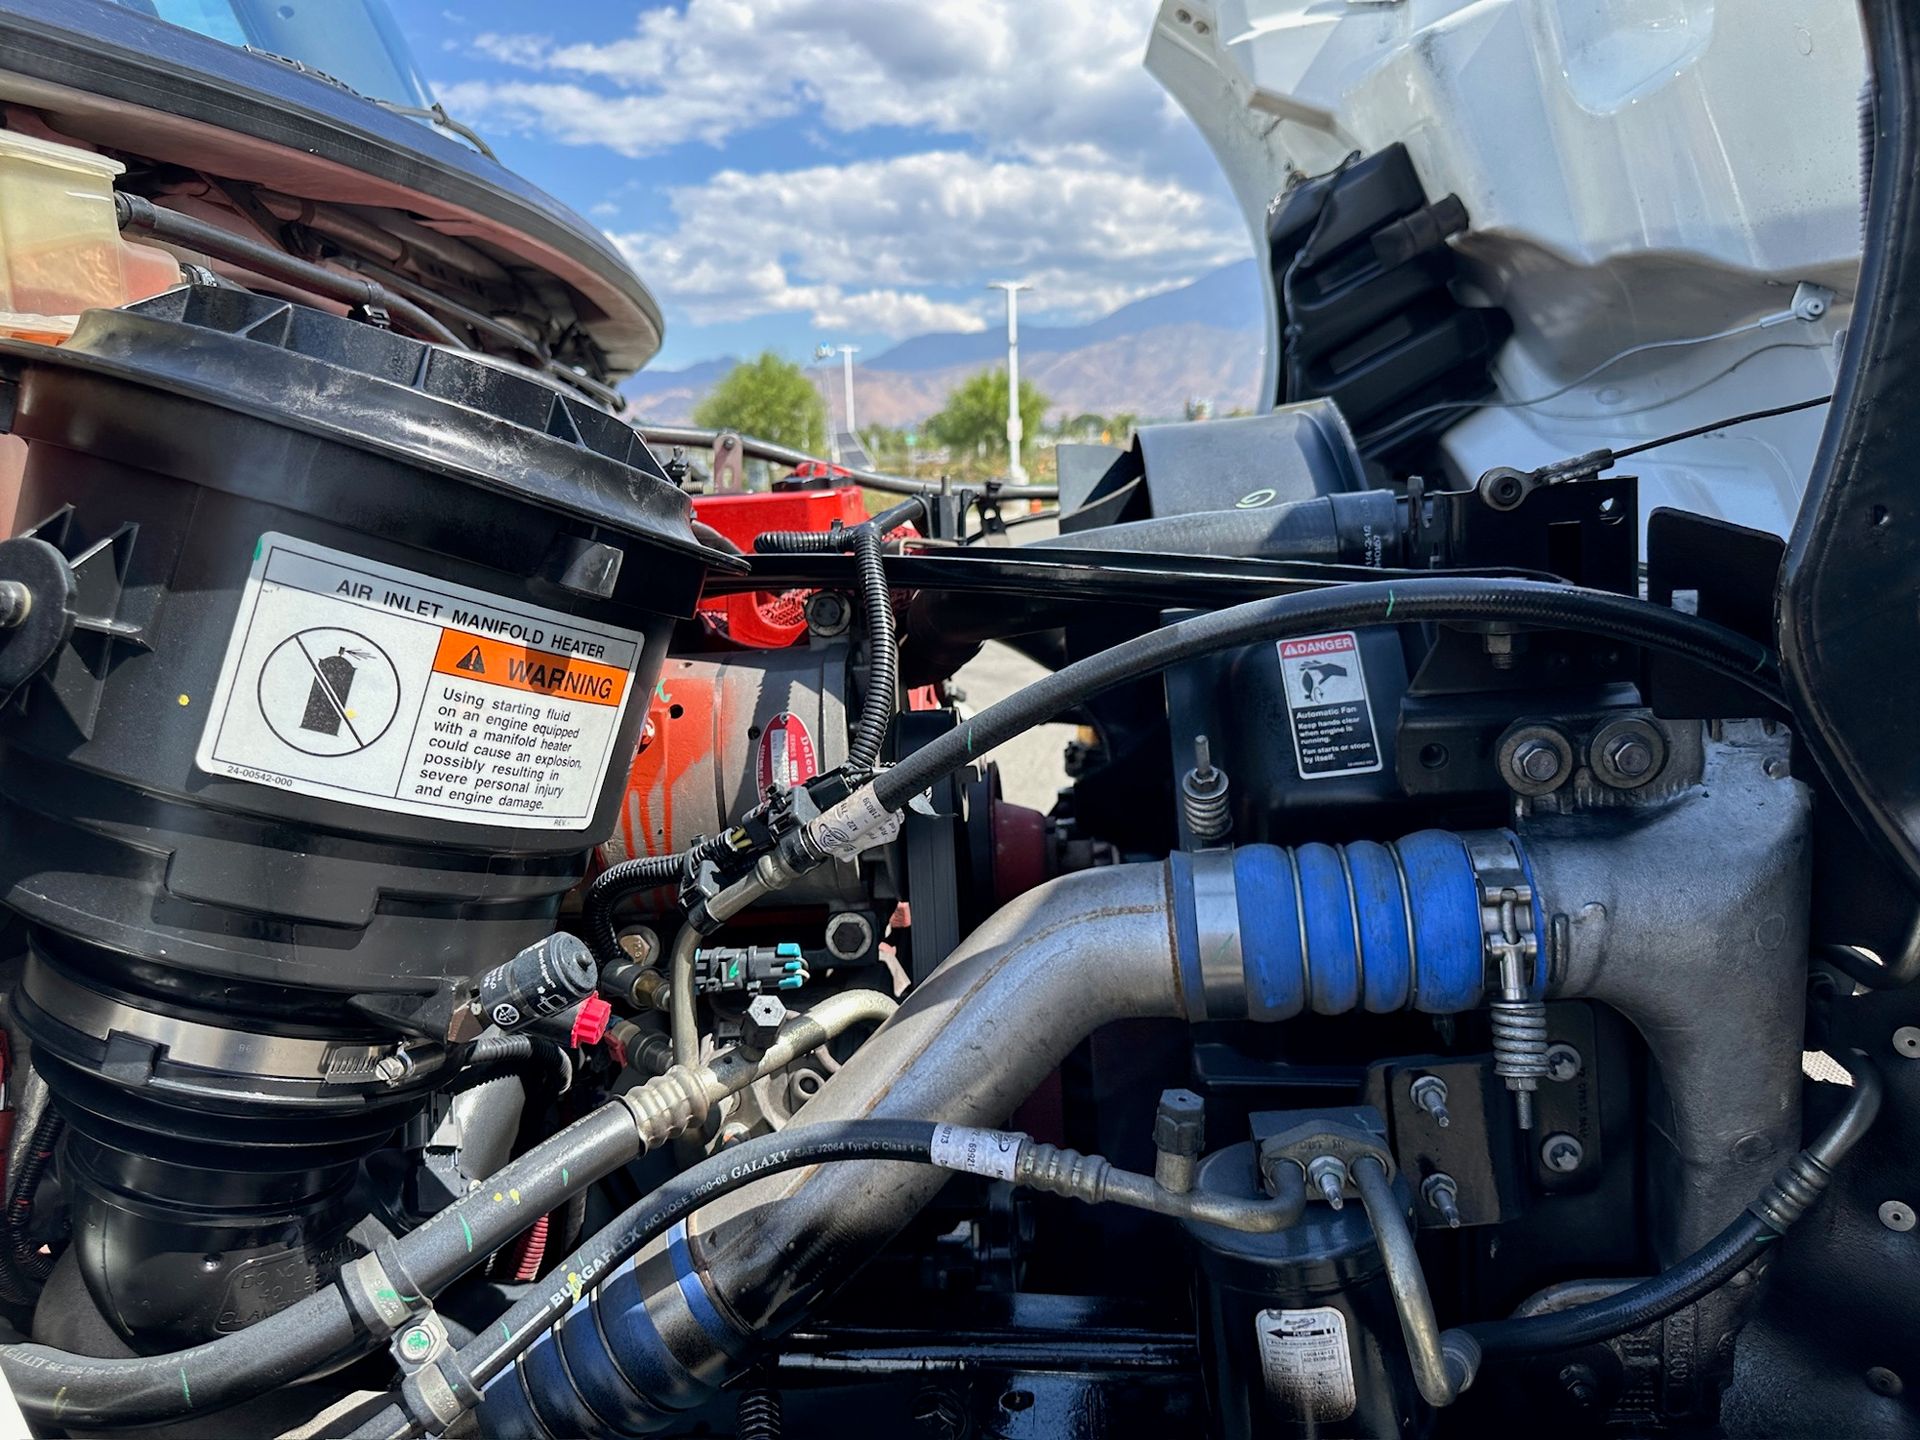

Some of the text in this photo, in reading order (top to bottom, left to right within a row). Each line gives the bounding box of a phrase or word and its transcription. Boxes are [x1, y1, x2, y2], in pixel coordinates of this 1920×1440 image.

[336, 579, 605, 659] AIR INLET MANIFOLD HEATER
[1296, 638, 1353, 654] DANGER
[507, 657, 614, 700] WARNING
[443, 687, 571, 722] Using starting fluid
[1296, 706, 1357, 719] Automatic Fan
[434, 720, 572, 752] with a manifold heater
[438, 705, 580, 740] on an engine equipped
[1297, 722, 1317, 730] Keep
[1317, 719, 1341, 727] hands
[1319, 727, 1345, 735] engine
[429, 737, 582, 771] could cause an explosion,
[800, 735, 813, 774] Delco
[1303, 756, 1313, 764] by
[1317, 746, 1339, 754] starts
[1349, 742, 1371, 750] stops
[226, 765, 293, 788] 24-00542-000
[423, 752, 560, 782] possibly resulting in
[415, 784, 545, 812] and engine damage.
[419, 768, 564, 799] severe personal injury
[731, 1149, 792, 1179] GALAXY
[795, 1145, 815, 1157] SAE
[848, 1141, 869, 1152] Type
[871, 1141, 879, 1149] C
[881, 1141, 908, 1151] Class
